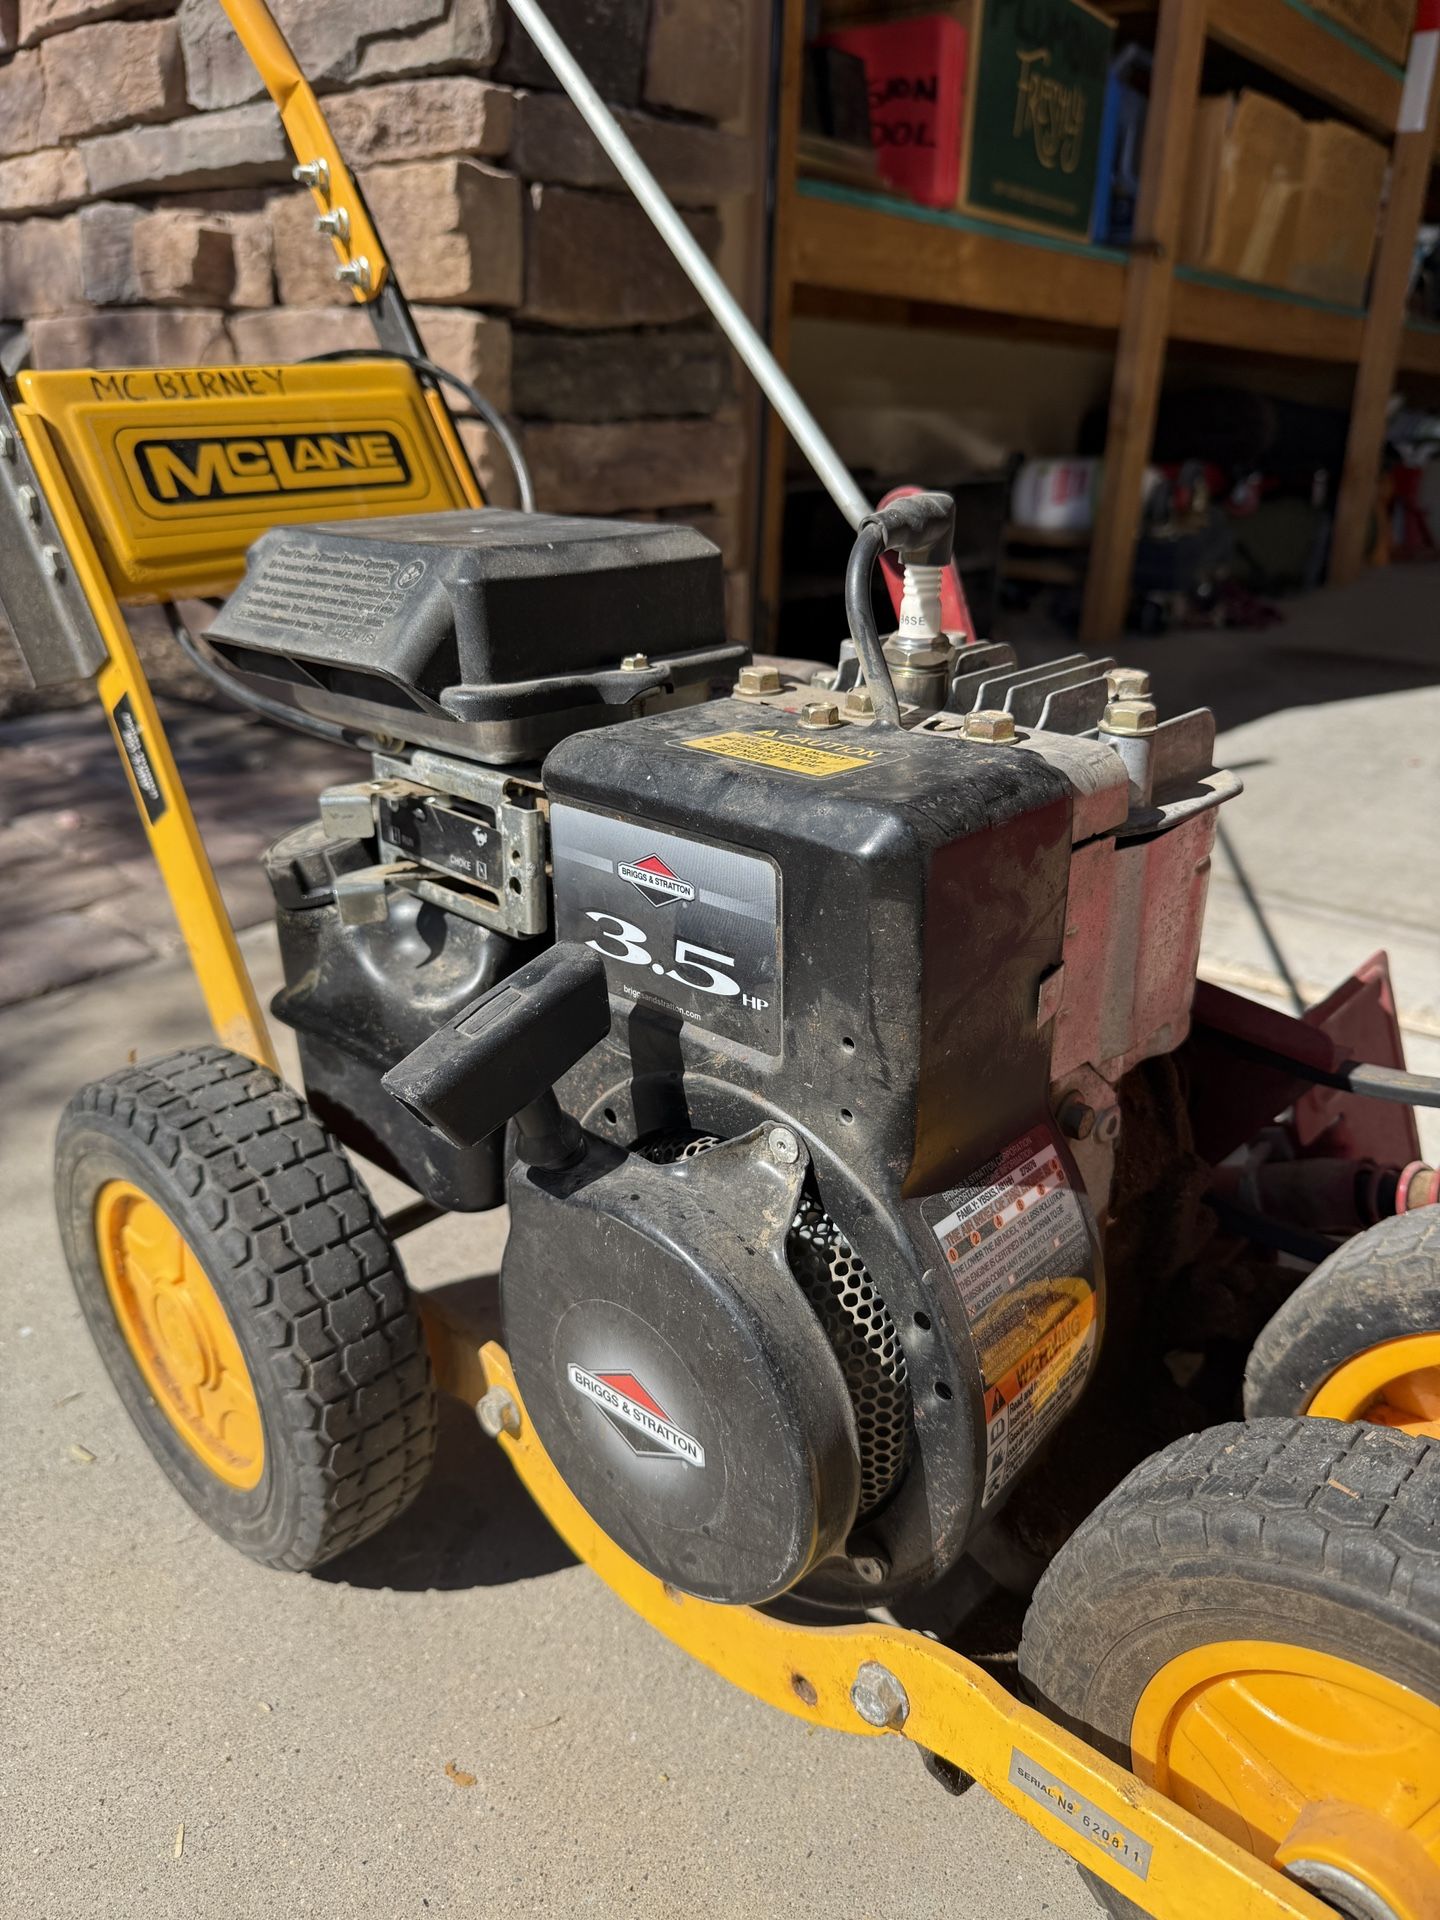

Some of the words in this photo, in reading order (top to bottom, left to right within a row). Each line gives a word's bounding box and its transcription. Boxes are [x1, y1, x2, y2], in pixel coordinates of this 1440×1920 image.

[90, 374, 146, 400] MC
[154, 367, 287, 399] BIRNEY
[779, 733, 883, 758] CAUTION
[450, 855, 472, 871] CHOKE
[621, 866, 647, 882] BRIGGS
[649, 875, 654, 884] &
[655, 877, 691, 896] STRATTON
[584, 911, 741, 996] 3.5
[743, 993, 769, 1011] HP
[956, 1199, 979, 1221] FAMILY:
[953, 1264, 964, 1277] THE
[963, 1250, 983, 1269] LOWER
[983, 1242, 994, 1254] THE
[1017, 1217, 1028, 1228] THE
[1027, 1208, 1039, 1221] LESS
[958, 1276, 971, 1290] THIS
[970, 1262, 989, 1281] ENGINE
[1023, 1214, 1050, 1238] CALIFORNIA
[574, 1370, 619, 1408] BRIGGS
[622, 1402, 631, 1415] &
[633, 1408, 697, 1458] STRATTON
[1017, 1766, 1054, 1798] SERIAL
[1082, 1815, 1139, 1862] 620811
